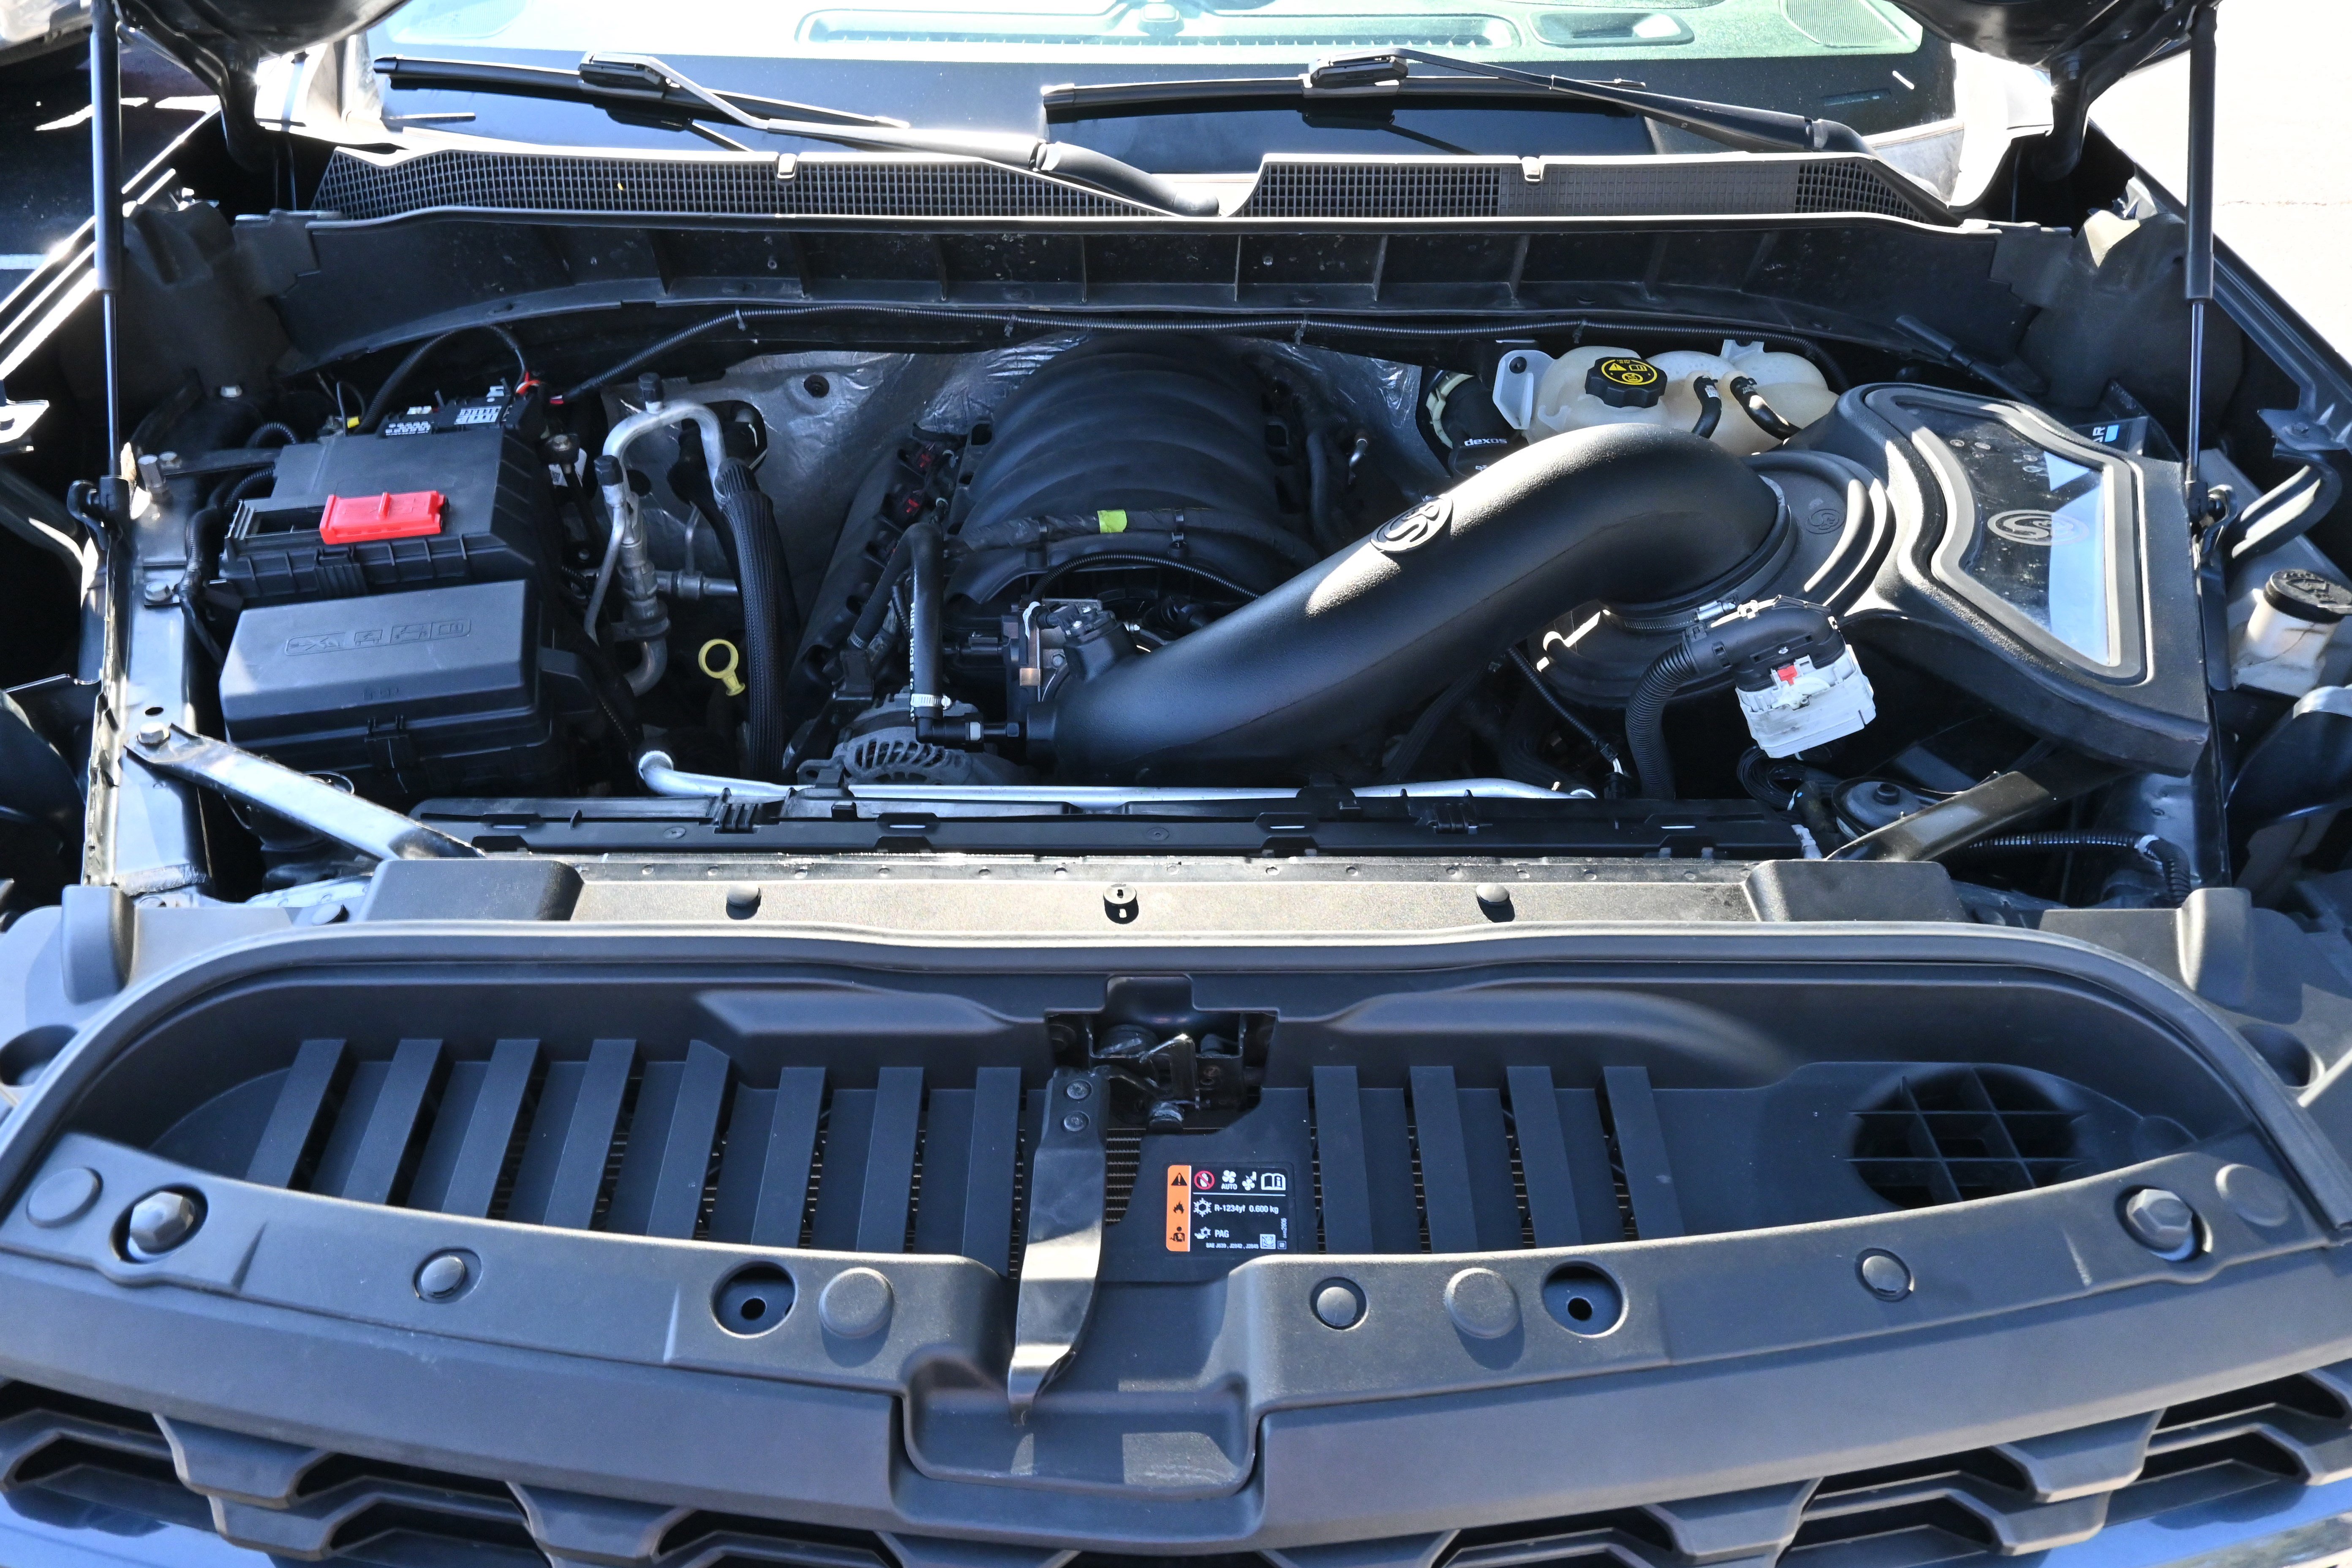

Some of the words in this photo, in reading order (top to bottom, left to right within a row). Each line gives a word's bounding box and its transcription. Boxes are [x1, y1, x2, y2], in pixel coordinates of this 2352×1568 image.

[1464, 438, 1508, 446] dexos
[1214, 1204, 1246, 1214] R-1234yf
[1249, 1205, 1269, 1213] 0.600
[1269, 1205, 1279, 1214] kg
[1214, 1229, 1229, 1238] PAG
